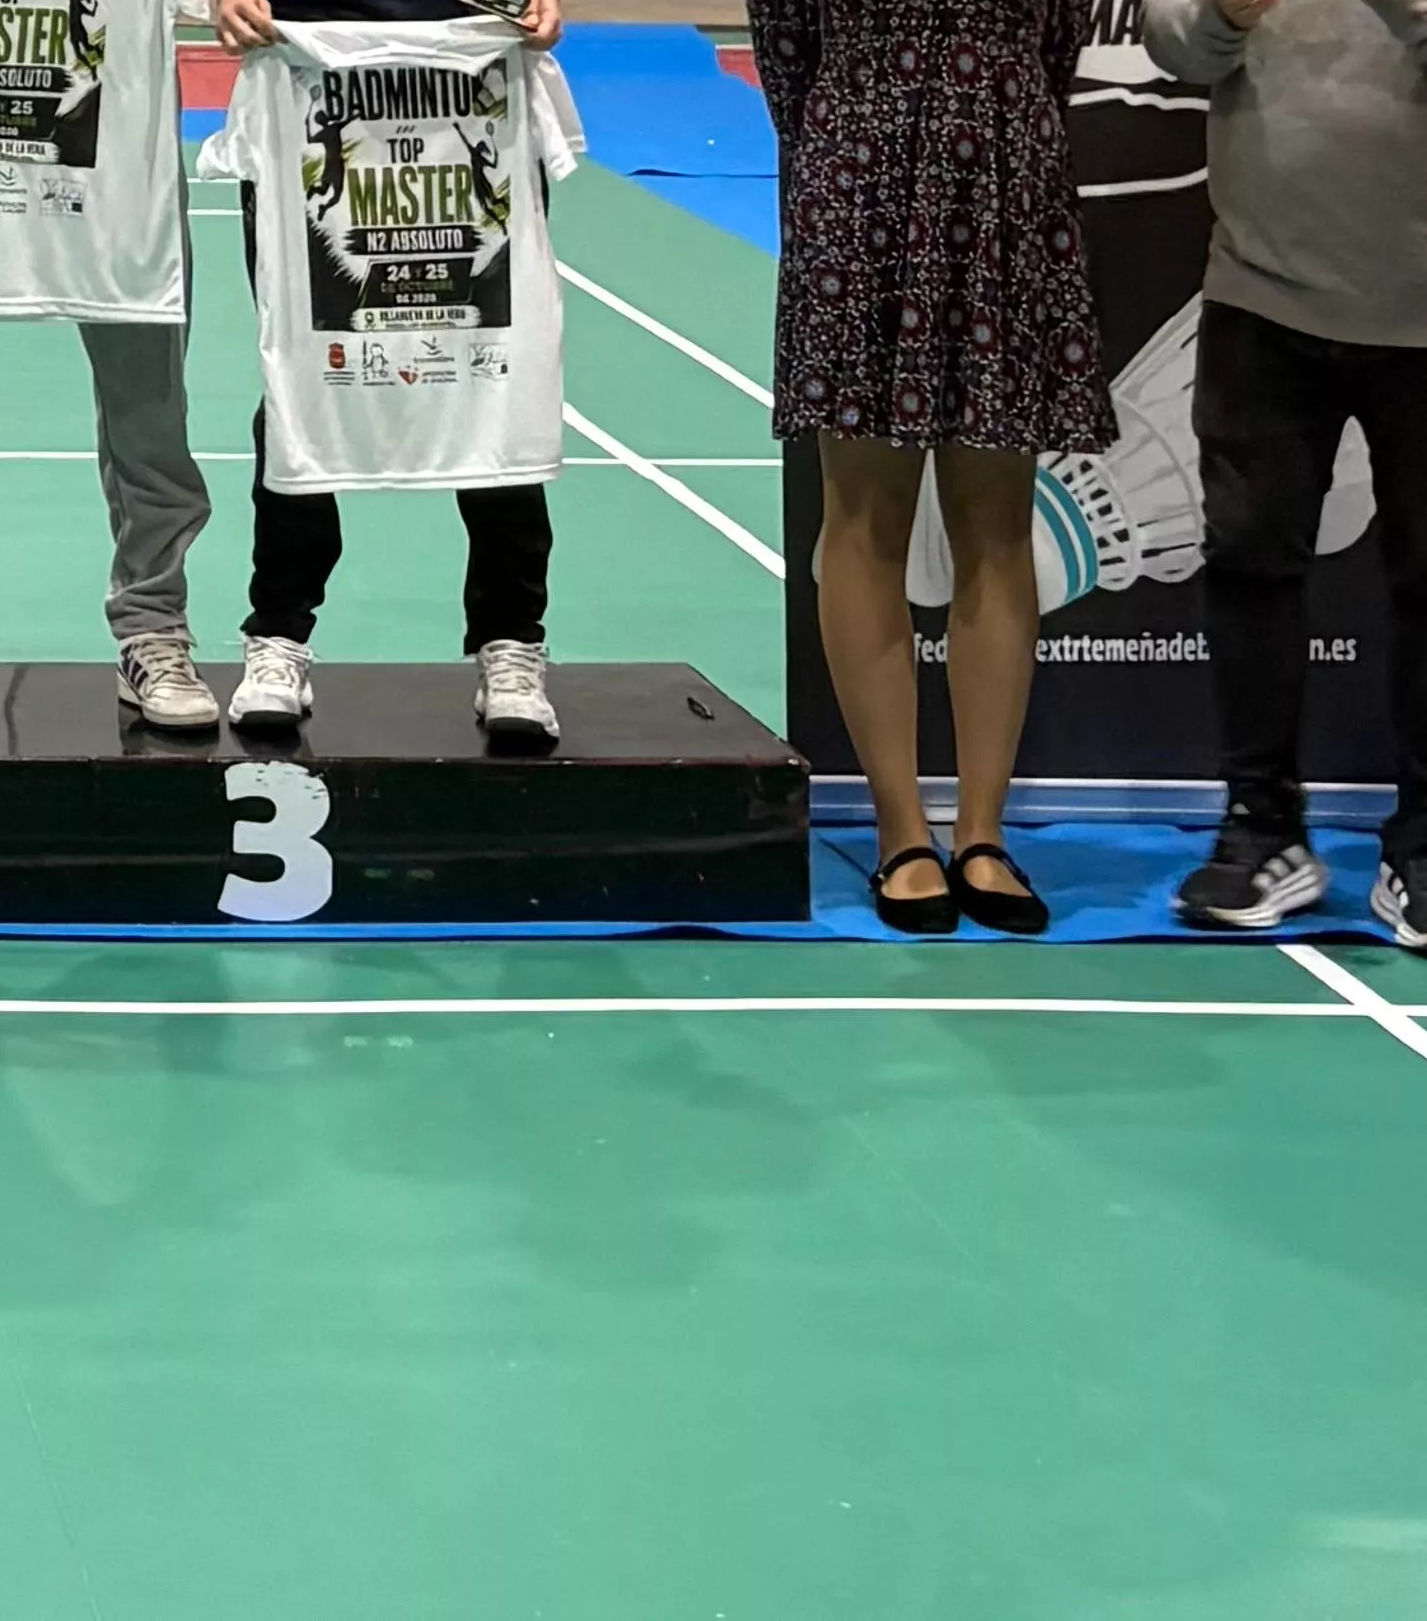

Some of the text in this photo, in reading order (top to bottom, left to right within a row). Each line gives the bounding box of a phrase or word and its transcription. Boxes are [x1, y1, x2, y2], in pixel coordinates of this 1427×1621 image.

[11, 100, 33, 114] 25
[387, 138, 424, 163] TOP
[347, 164, 474, 227] MASTER
[367, 230, 464, 252] N2 ABSOLUTO
[388, 263, 448, 281] 24 25
[221, 761, 334, 916] 3
